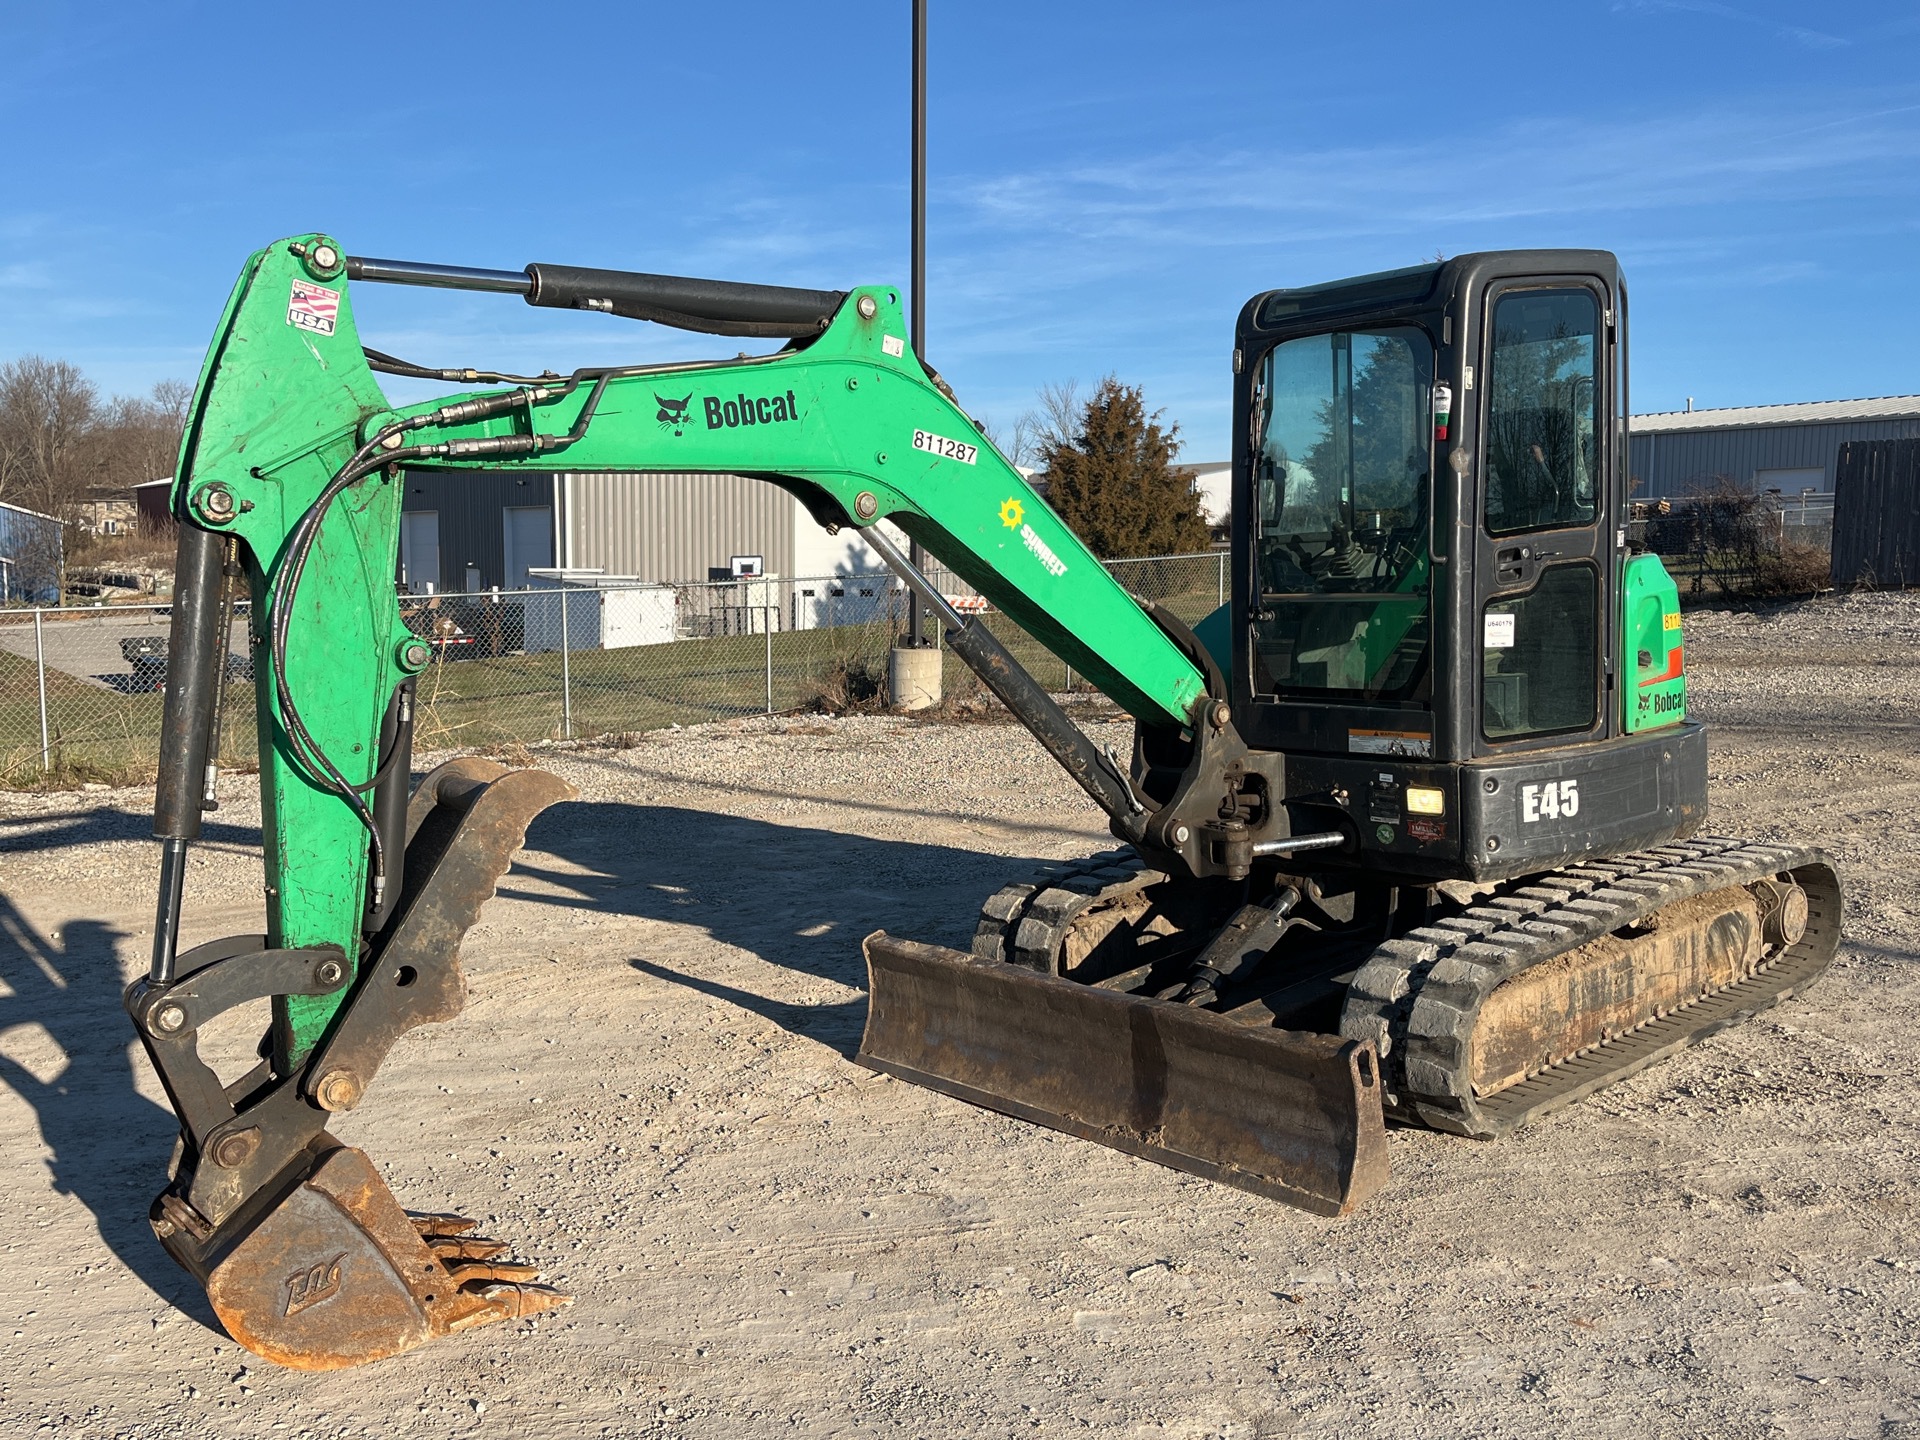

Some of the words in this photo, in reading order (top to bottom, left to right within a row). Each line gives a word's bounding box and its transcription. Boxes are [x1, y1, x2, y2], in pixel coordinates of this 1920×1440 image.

[290, 310, 332, 332] USA
[703, 390, 798, 430] Bobcat
[914, 431, 977, 462] 811287
[1020, 523, 1068, 577] SUNBELT
[1022, 539, 1056, 576] RENTALS
[1522, 779, 1579, 823] E45
